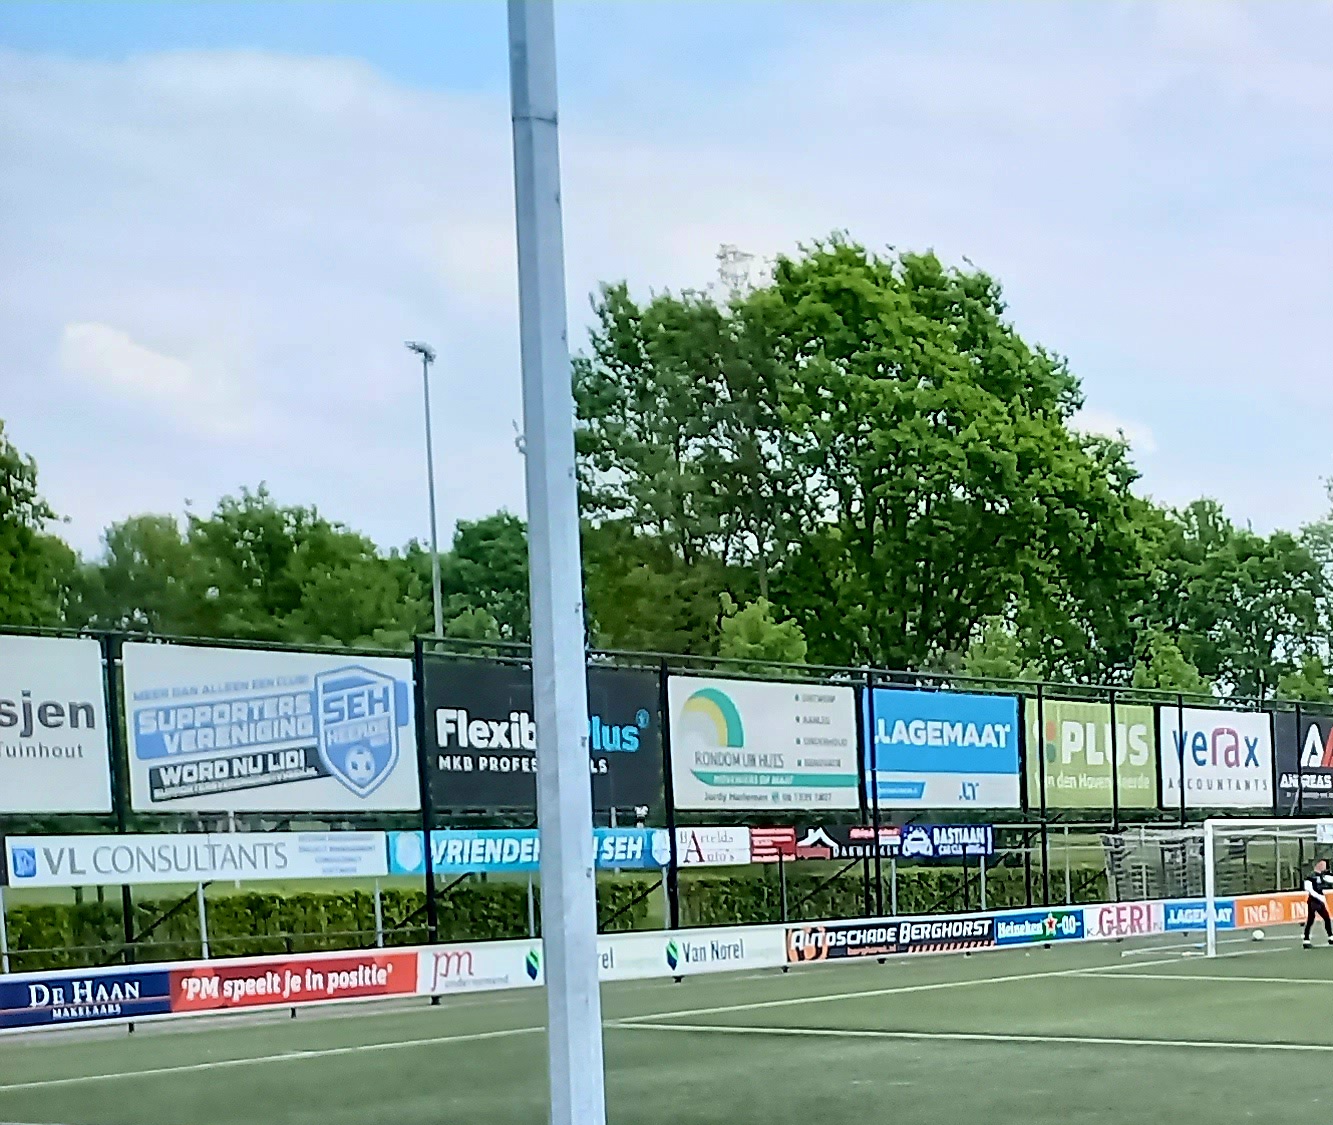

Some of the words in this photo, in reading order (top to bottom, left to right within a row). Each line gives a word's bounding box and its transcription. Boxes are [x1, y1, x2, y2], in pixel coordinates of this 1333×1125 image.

[139, 693, 311, 735] SUPPORTERS
[323, 685, 390, 725] SEH
[163, 715, 314, 754] VERENIGING
[1062, 721, 1149, 766] PLUS
[1172, 727, 1260, 768] verax
[159, 760, 230, 787] WORD
[234, 754, 263, 778] NU
[268, 749, 306, 774] LID!
[439, 755, 473, 772] MKB
[695, 751, 740, 768] RONDOM
[43, 847, 87, 876] VL
[92, 842, 289, 875] CONSULTANTS
[602, 836, 643, 861] SEH
[1243, 904, 1269, 924] ING
[1291, 901, 1306, 919] IN
[792, 927, 897, 951] AUTOSCHADE
[899, 920, 992, 943] BERGHORST
[998, 919, 1043, 938] Heineken
[683, 942, 706, 962] Van
[711, 938, 744, 961] Norel
[71, 979, 140, 1001] HAAN
[222, 971, 280, 1001] speelt
[283, 969, 301, 998] je
[305, 967, 323, 991] in
